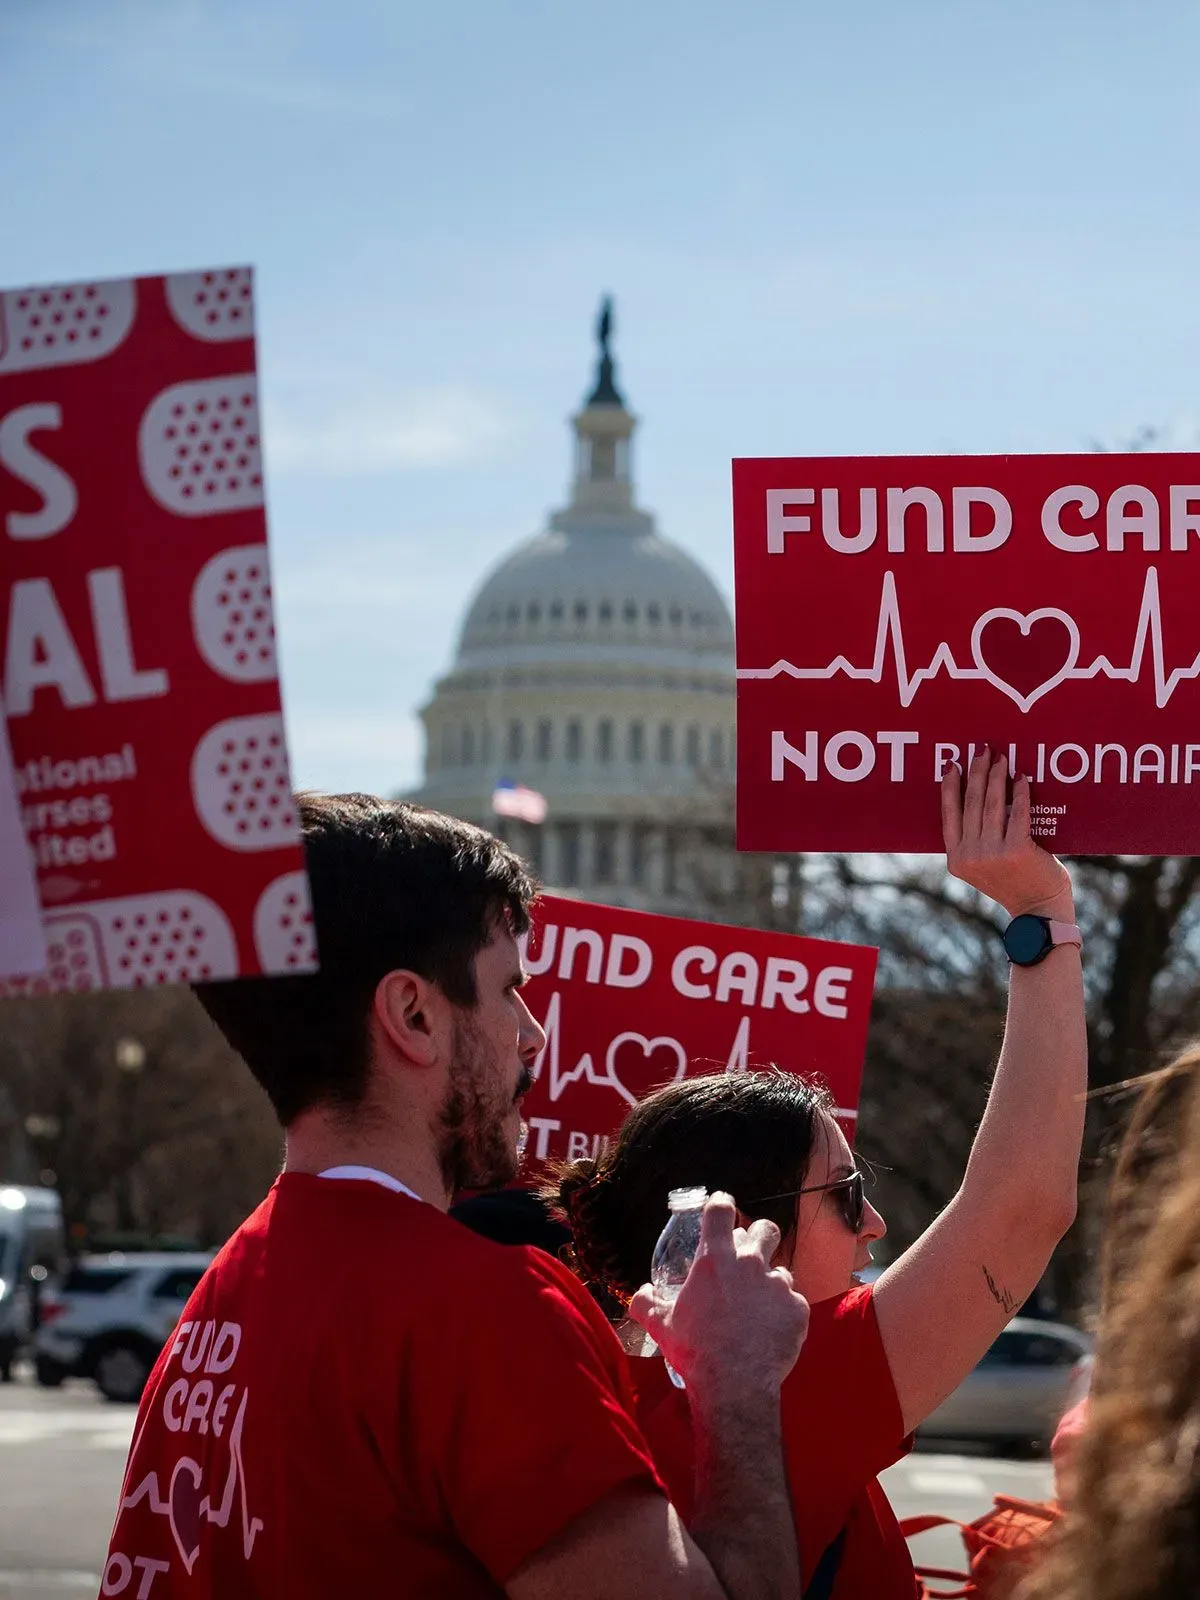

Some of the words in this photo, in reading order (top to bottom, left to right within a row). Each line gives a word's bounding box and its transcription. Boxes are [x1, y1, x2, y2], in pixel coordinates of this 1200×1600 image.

[766, 486, 1013, 554] FUND
[4, 566, 170, 715] AL
[771, 730, 919, 783] NOT
[1029, 817, 1057, 825] urses
[1029, 826, 1056, 836] nited
[1030, 804, 1067, 815] ational
[36, 823, 117, 868] ited
[516, 923, 653, 989] UND
[670, 945, 853, 1019] CARE
[102, 1551, 170, 1600] OT
